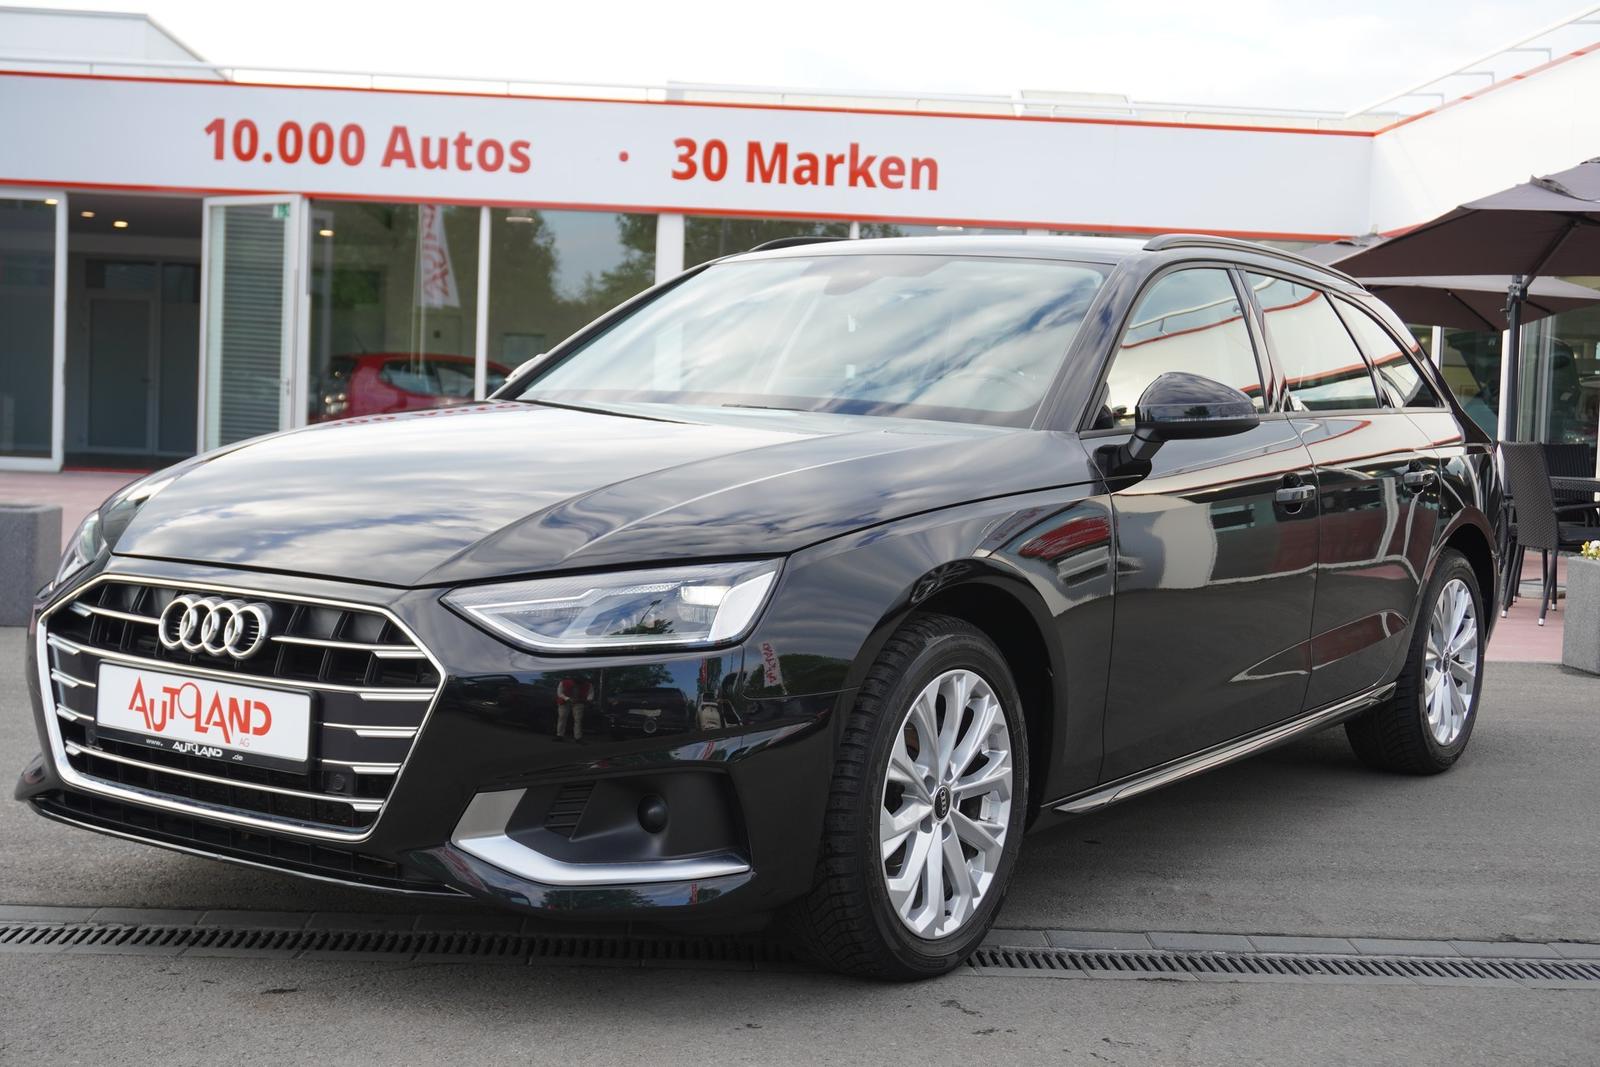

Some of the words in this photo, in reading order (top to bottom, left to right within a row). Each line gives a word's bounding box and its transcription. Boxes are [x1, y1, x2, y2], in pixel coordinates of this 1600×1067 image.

[204, 117, 366, 167] 10.000
[380, 125, 532, 174] Autos
[671, 137, 729, 182] 30
[745, 140, 939, 191] Marken
[239, 737, 250, 748] AG
